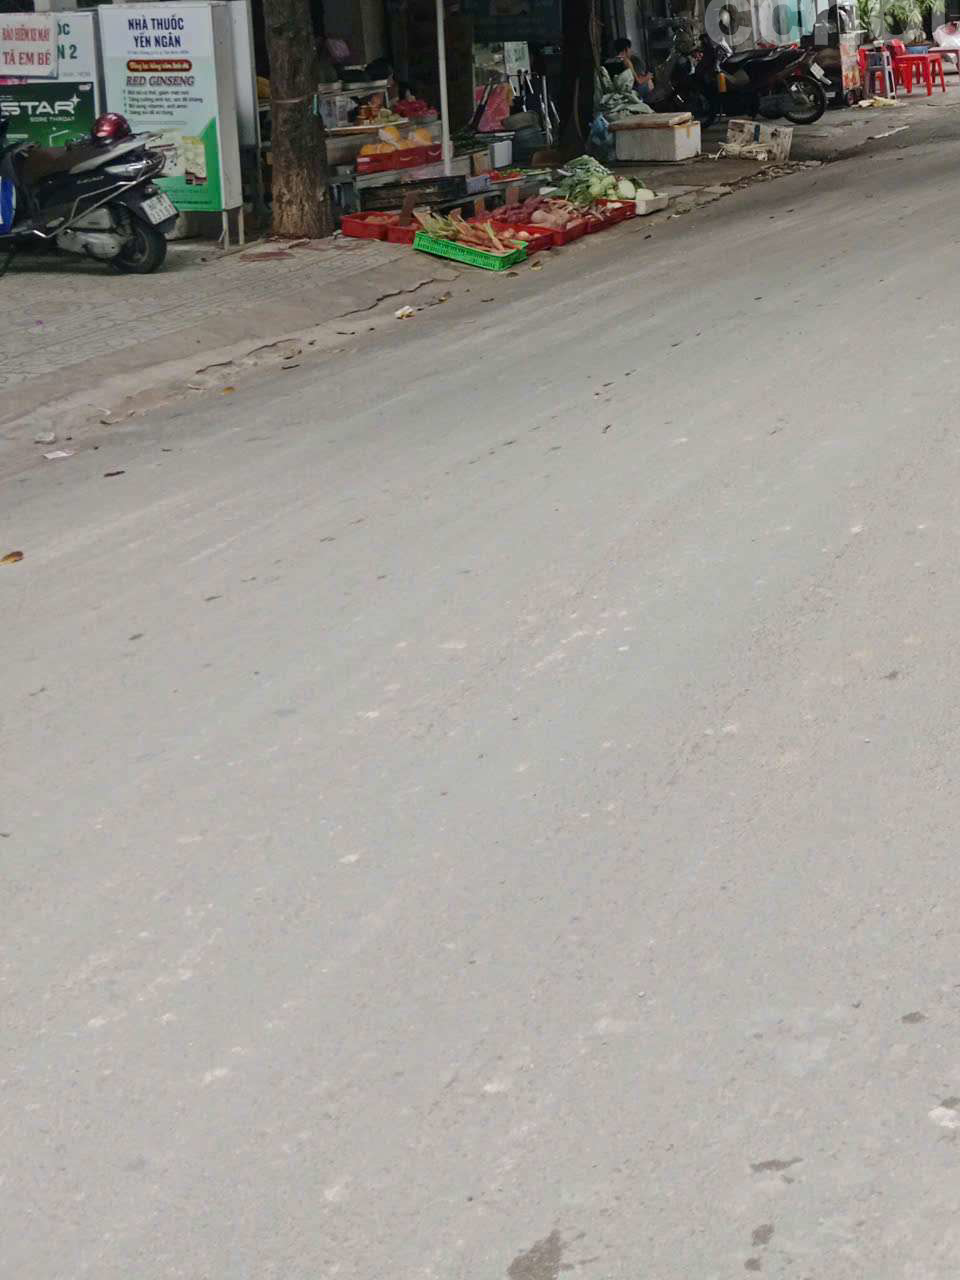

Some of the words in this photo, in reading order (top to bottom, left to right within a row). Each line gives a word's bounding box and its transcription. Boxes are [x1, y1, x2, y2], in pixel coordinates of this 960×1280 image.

[128, 15, 148, 31] NHÀ
[151, 13, 185, 31] THUỐC
[19, 52, 34, 65] EM
[149, 75, 195, 87] GINSENG
